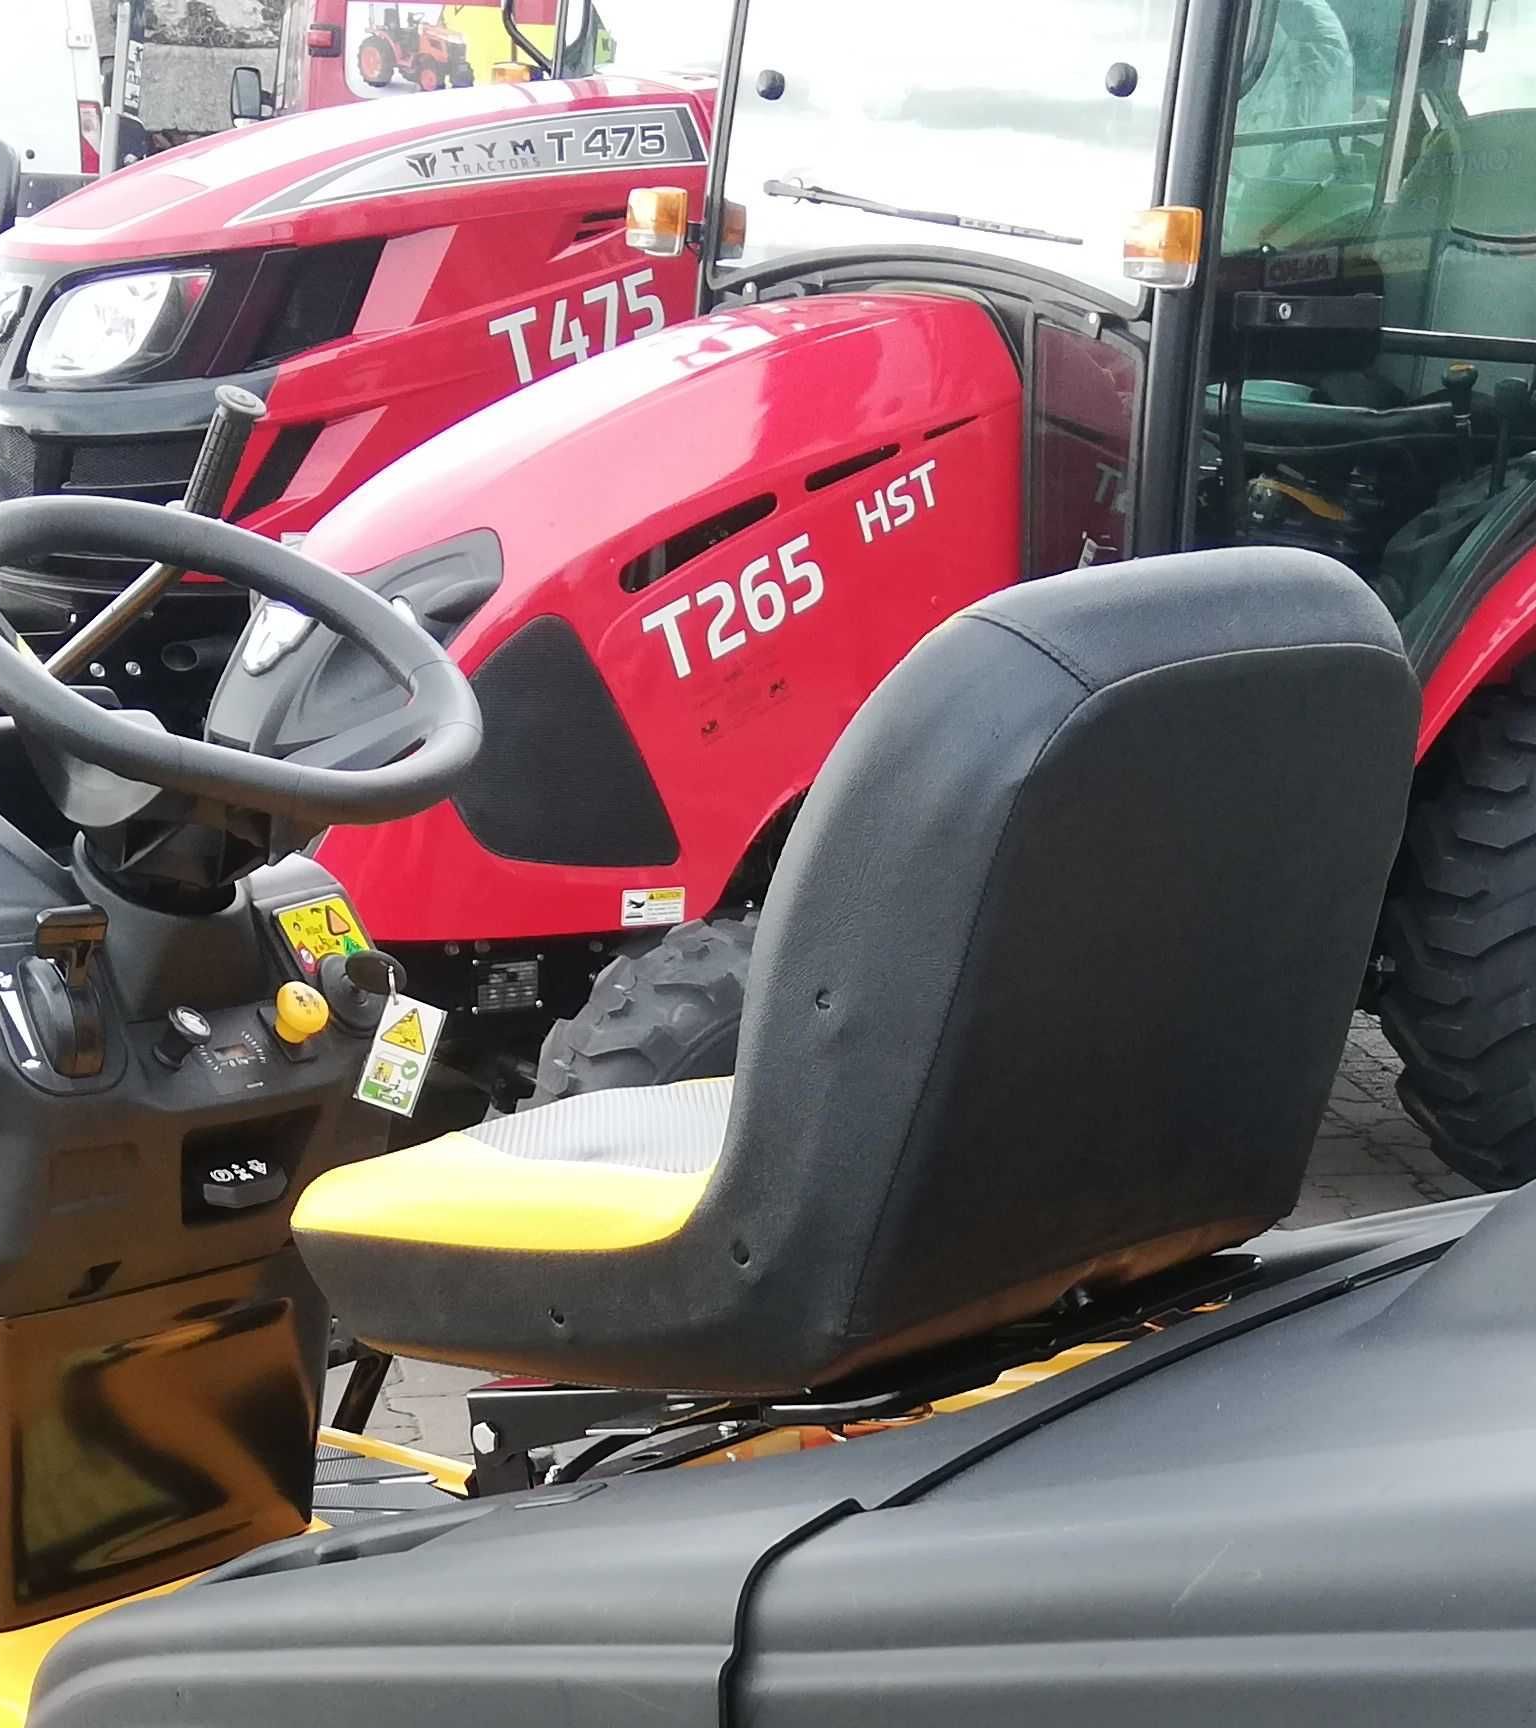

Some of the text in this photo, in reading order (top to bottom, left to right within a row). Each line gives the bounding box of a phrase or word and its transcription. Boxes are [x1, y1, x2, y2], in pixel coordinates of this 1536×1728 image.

[441, 138, 536, 163] TYM
[450, 156, 541, 177] TRACTORS
[488, 267, 666, 385] T475
[640, 458, 937, 679] T265 HST
